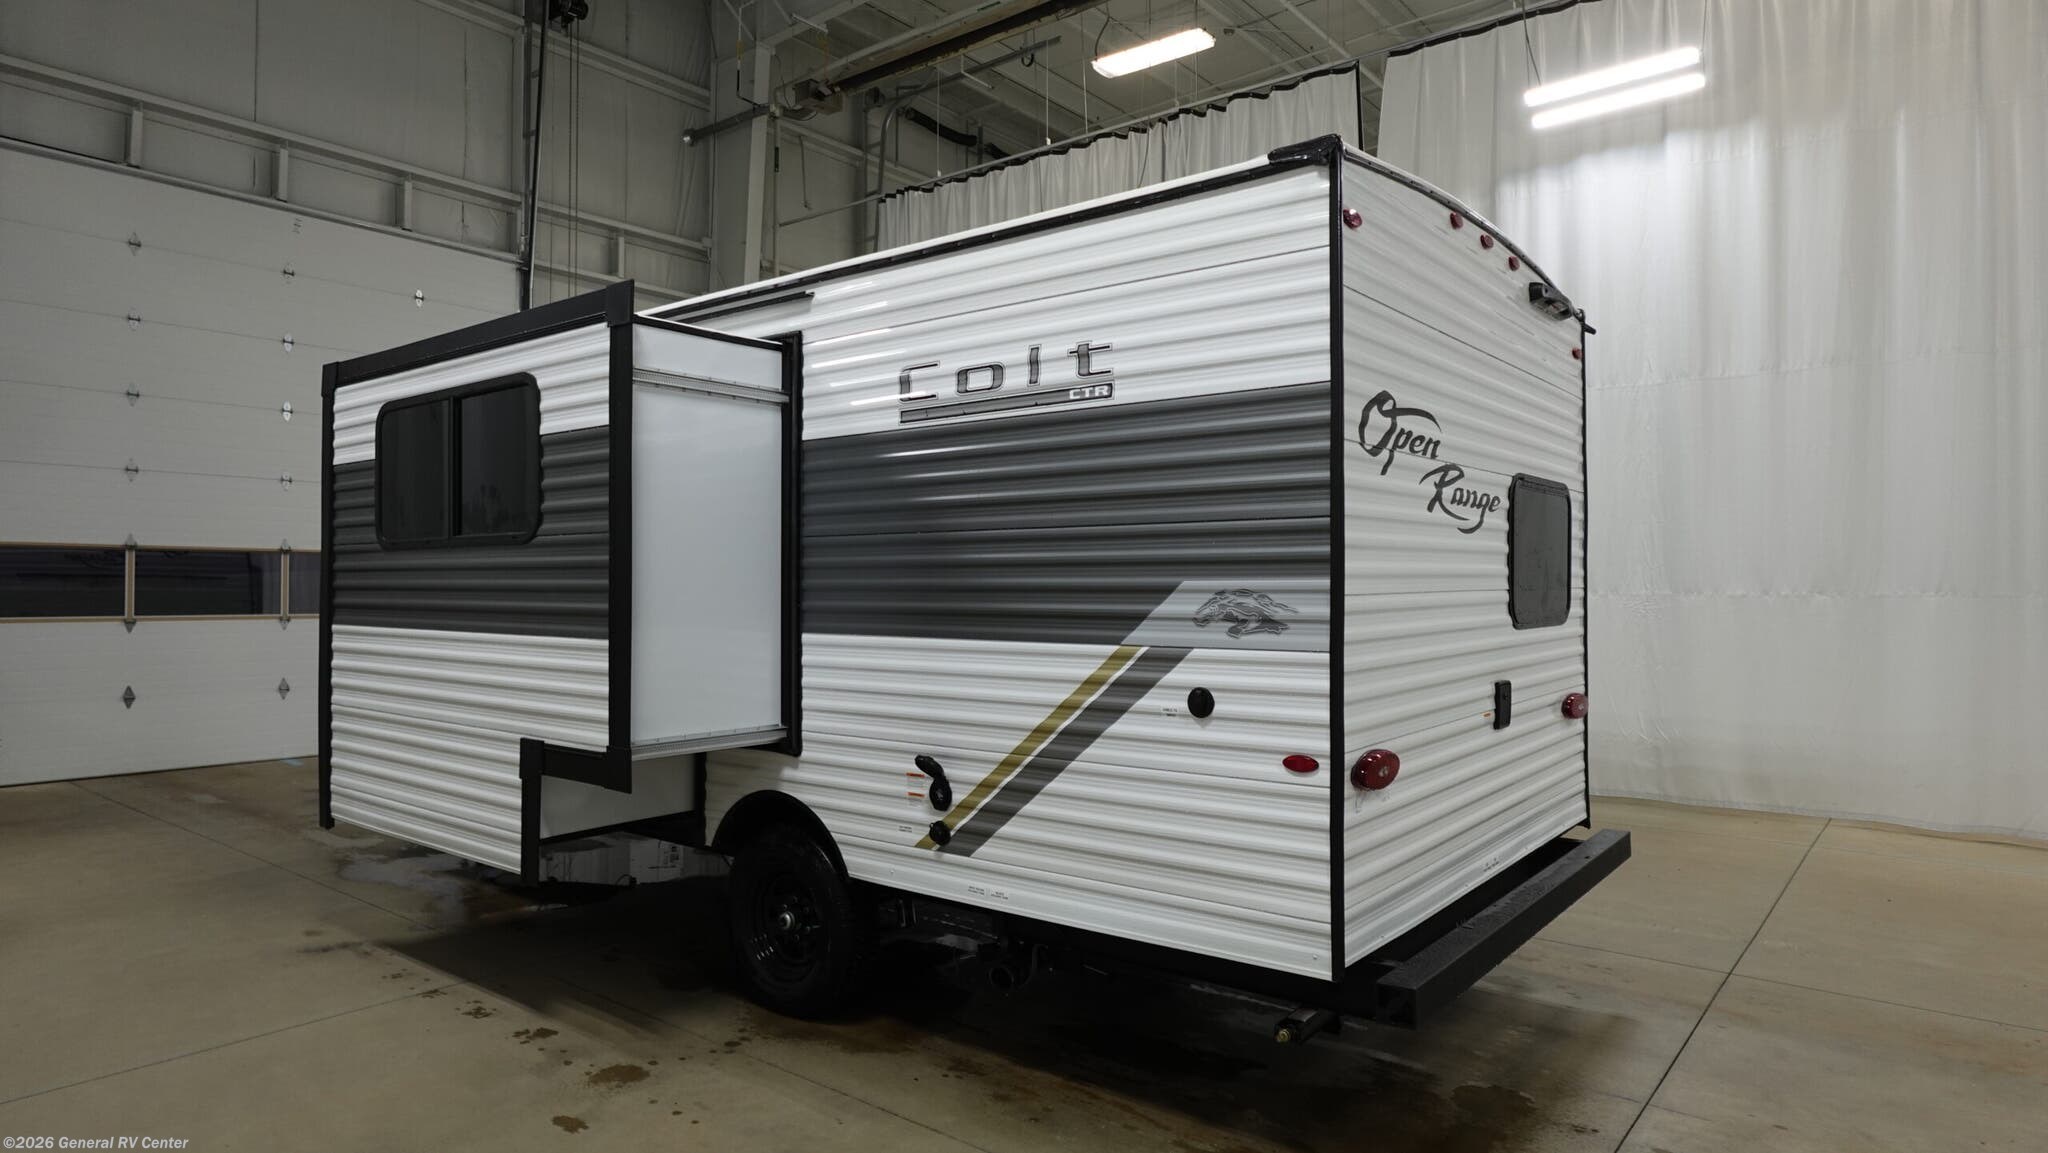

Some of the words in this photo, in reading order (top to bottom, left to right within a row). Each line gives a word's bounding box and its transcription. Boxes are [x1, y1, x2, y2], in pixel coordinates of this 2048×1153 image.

[899, 341, 1112, 402] Colt
[1069, 385, 1109, 400] CTR
[1358, 390, 1442, 475] Open
[1419, 463, 1501, 534] Range
